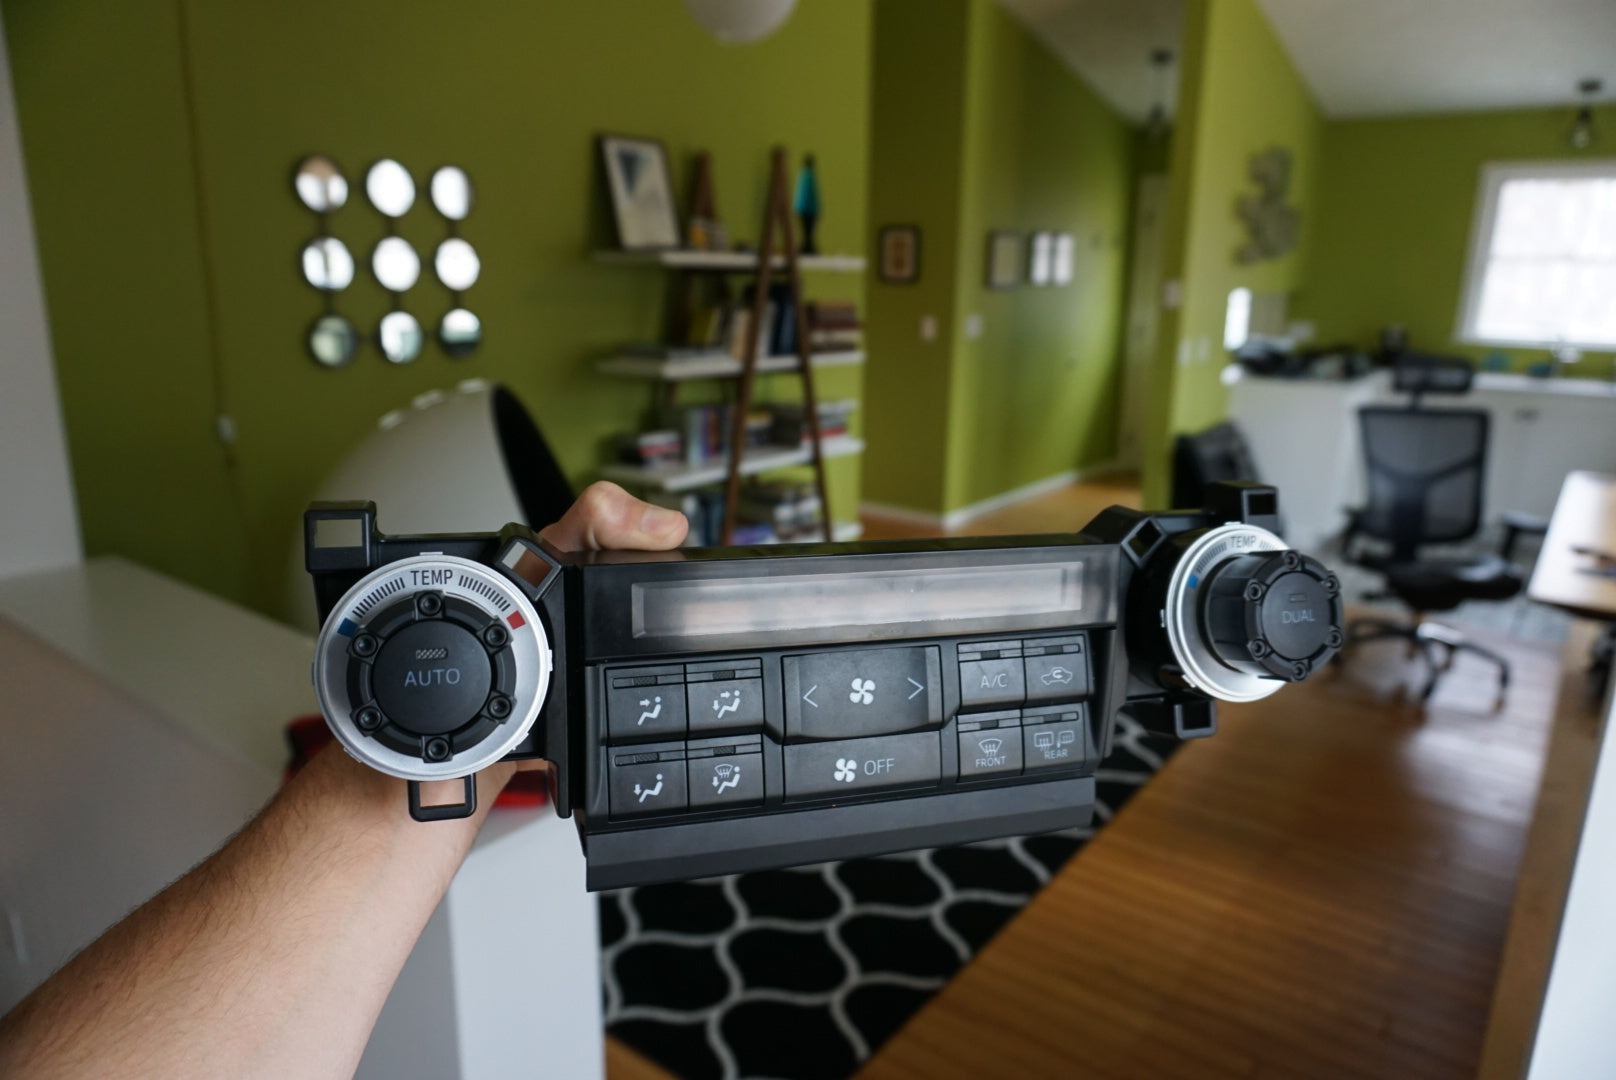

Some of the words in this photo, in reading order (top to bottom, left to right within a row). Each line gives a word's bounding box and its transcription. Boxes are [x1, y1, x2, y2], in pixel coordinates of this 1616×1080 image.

[1230, 535, 1257, 549] TEMP
[410, 569, 454, 586] TEMP
[1281, 609, 1315, 624] DUAL
[404, 668, 461, 687] AUTO
[980, 672, 1008, 689] A/C
[975, 756, 1006, 768] FRONT
[1044, 748, 1069, 760] REAR
[864, 758, 895, 776] OFF
